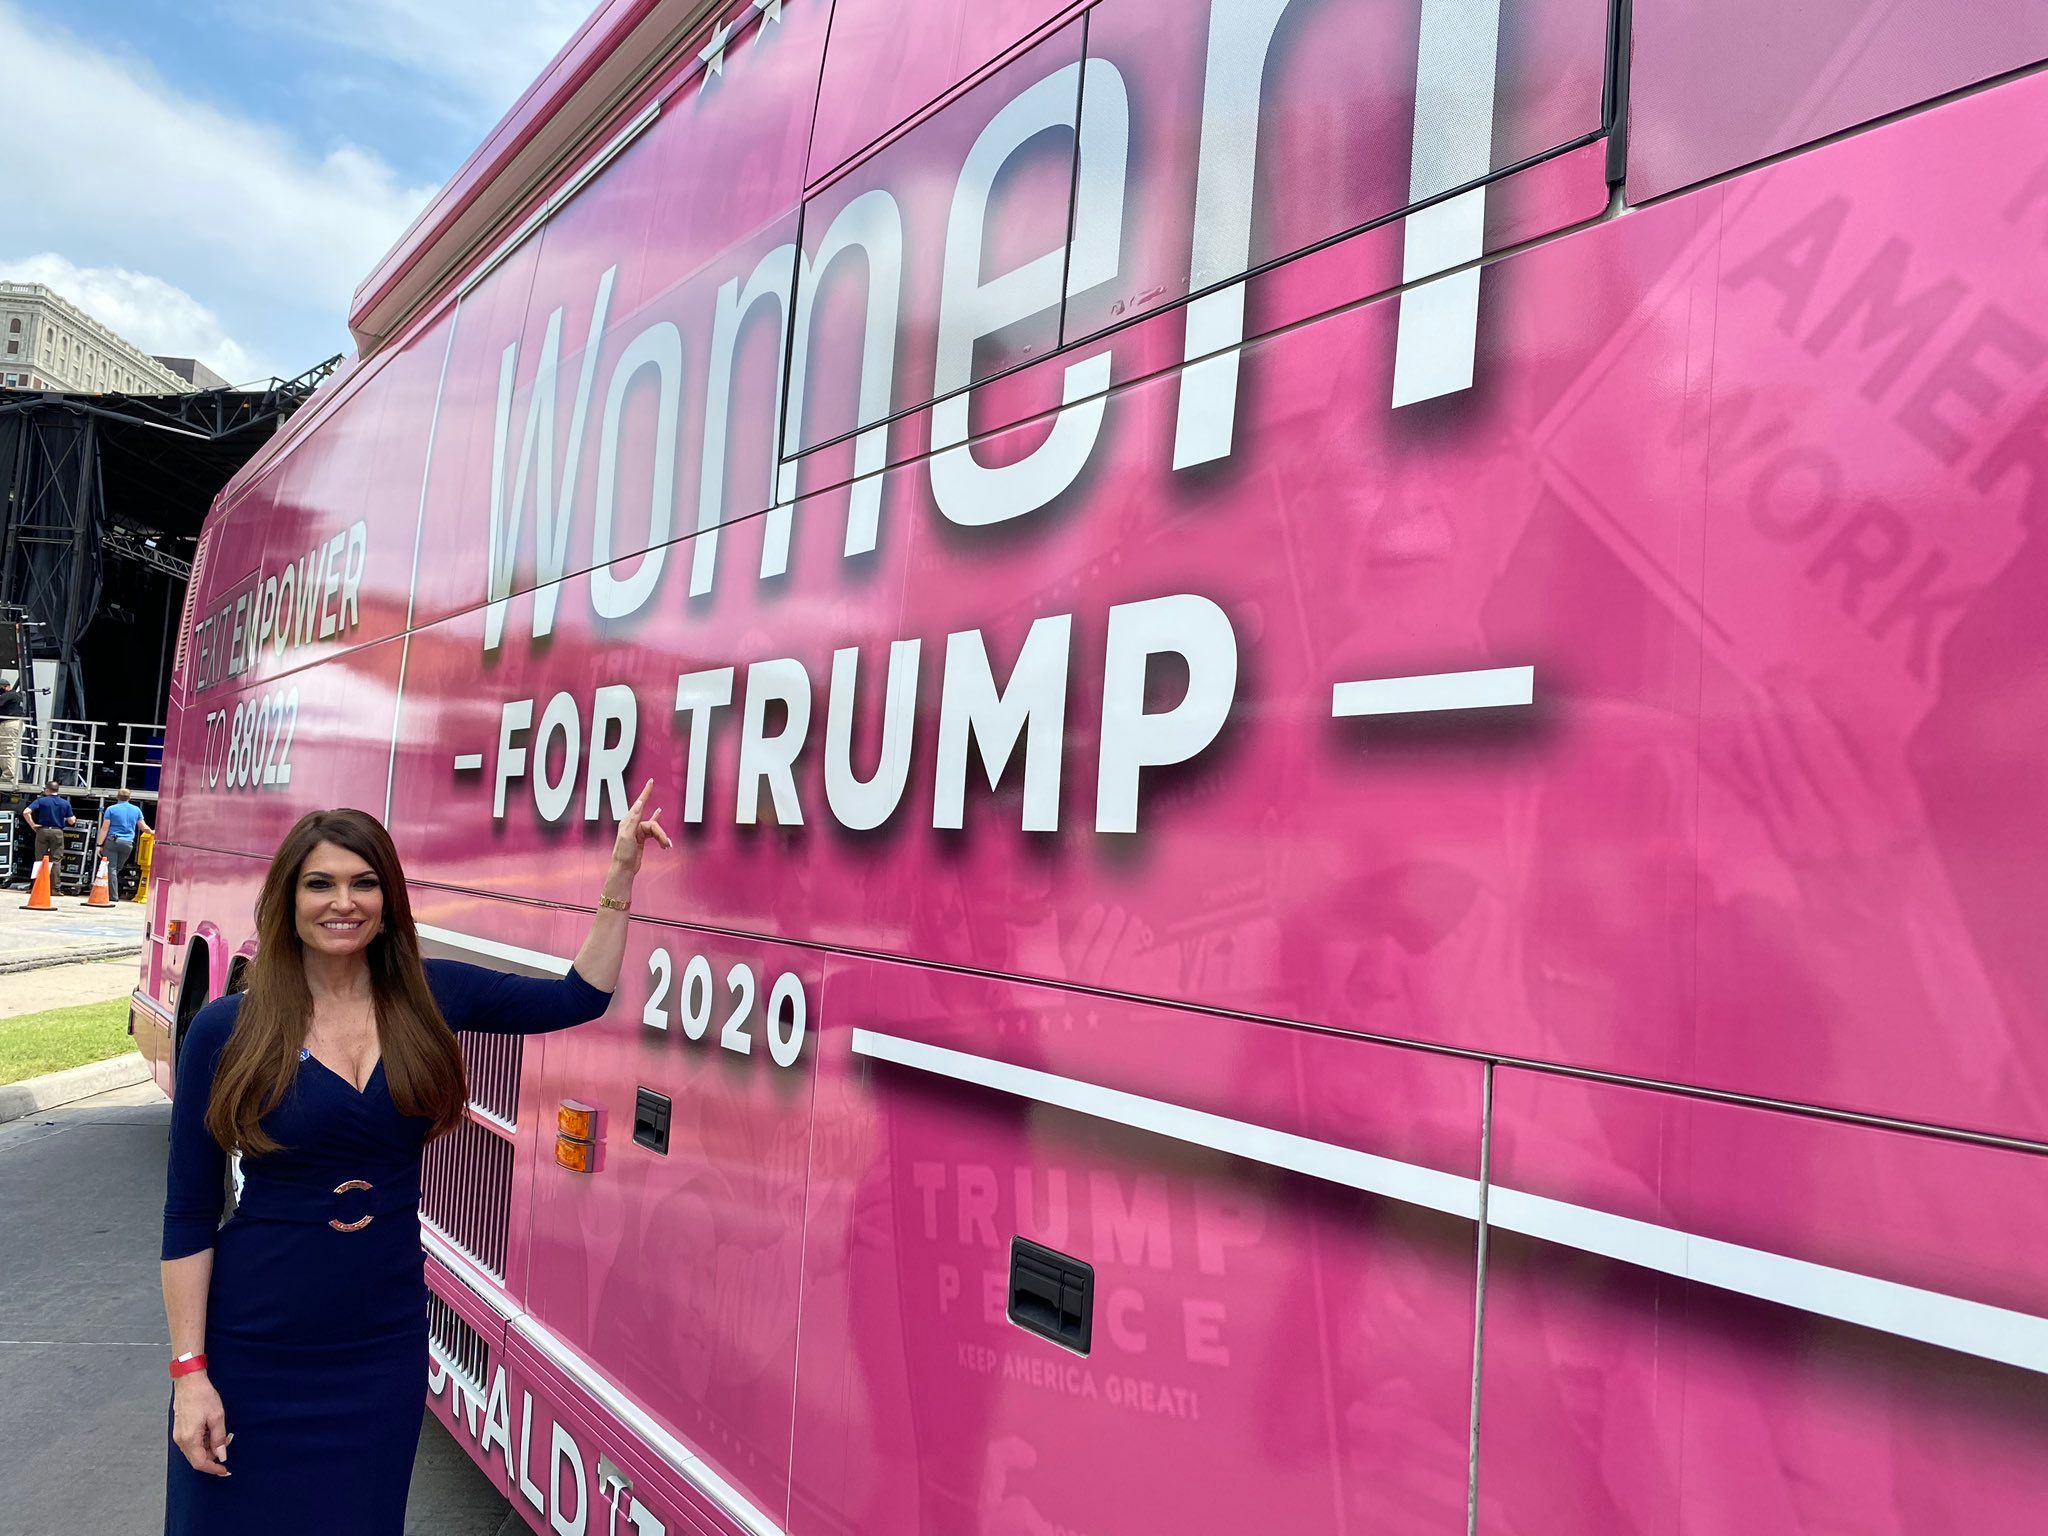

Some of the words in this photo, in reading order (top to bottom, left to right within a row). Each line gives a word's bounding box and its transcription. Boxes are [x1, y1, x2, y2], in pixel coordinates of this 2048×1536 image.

[483, 0, 1500, 650] Women
[194, 604, 231, 691] TEXT
[229, 519, 366, 678] EMPOWER
[201, 708, 226, 788] TO
[226, 686, 298, 789] 88022
[492, 683, 637, 822] FOR
[675, 594, 1237, 833] TRUMP
[642, 947, 807, 1068] 2020
[912, 1160, 1267, 1277] TRUMP
[938, 1263, 1230, 1368] PECE
[957, 1342, 997, 1373] KEEP
[1003, 1352, 1098, 1400] AMERICA
